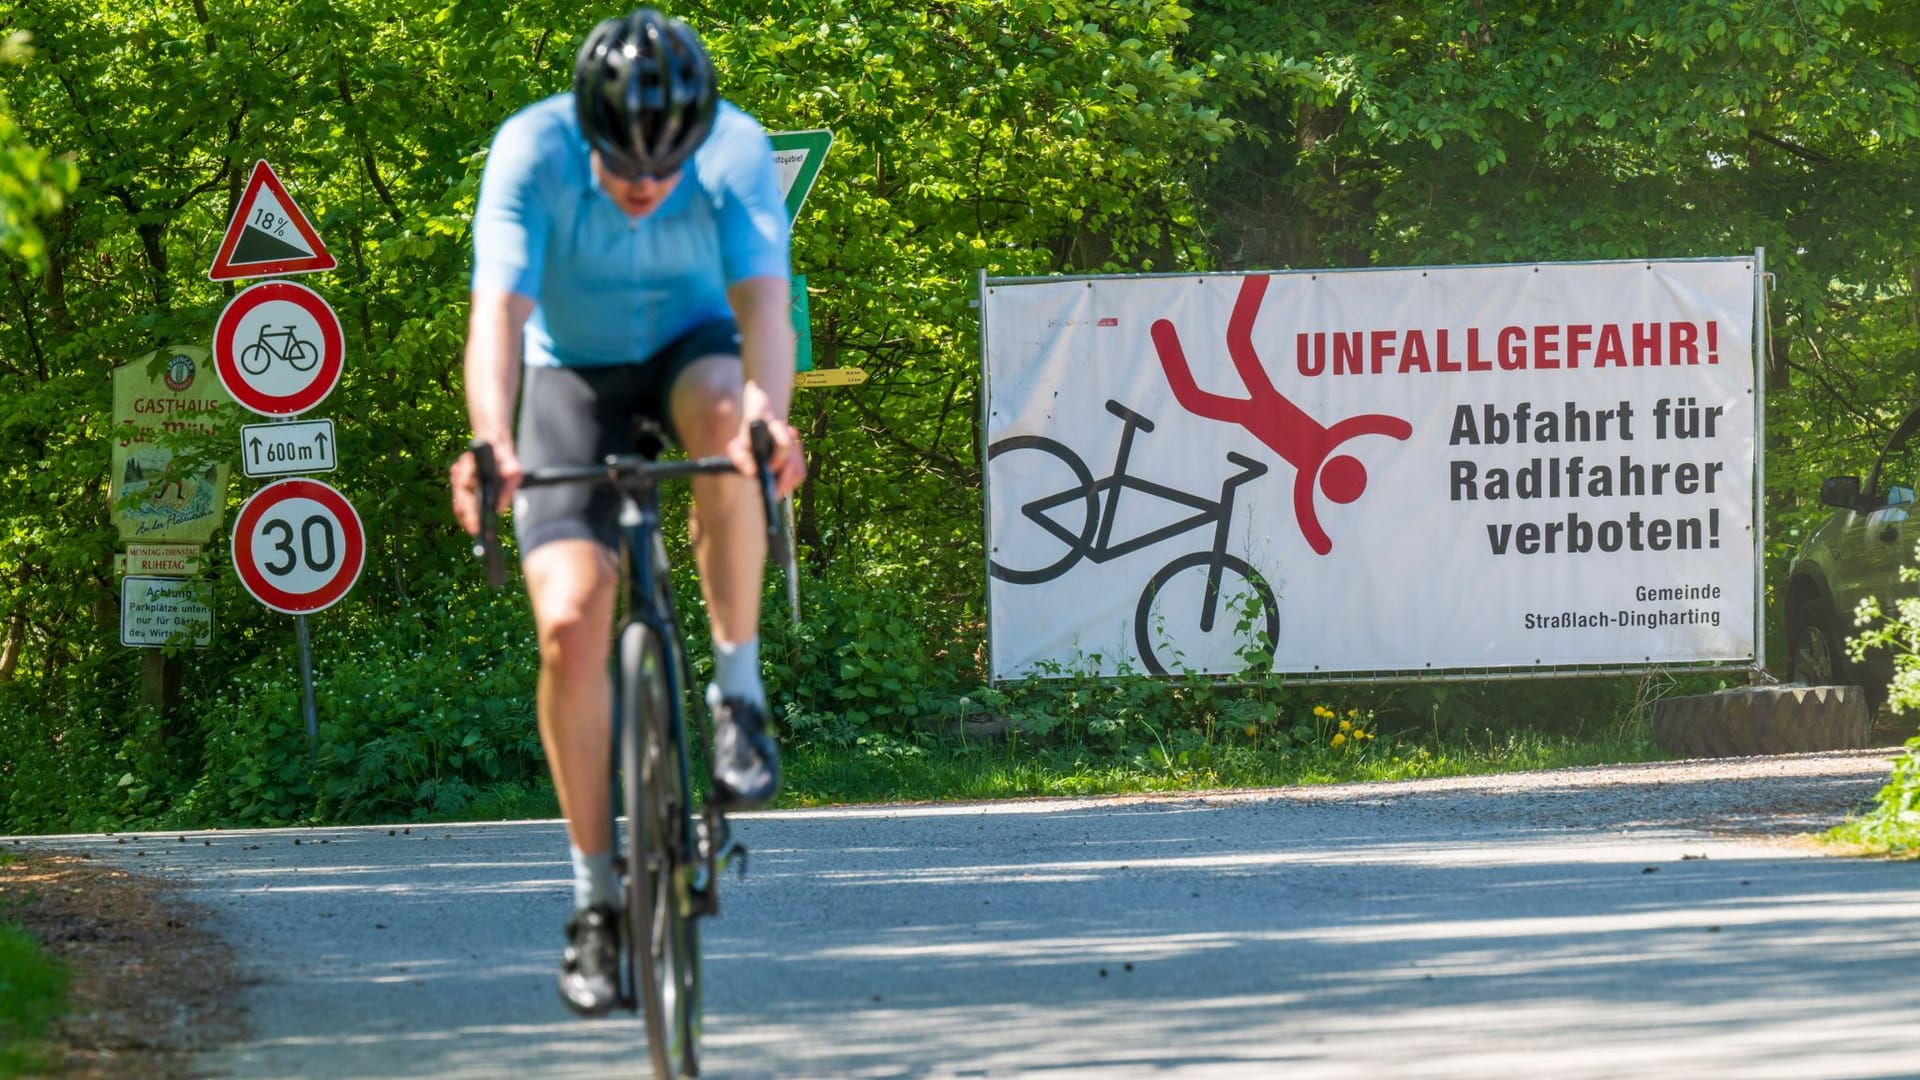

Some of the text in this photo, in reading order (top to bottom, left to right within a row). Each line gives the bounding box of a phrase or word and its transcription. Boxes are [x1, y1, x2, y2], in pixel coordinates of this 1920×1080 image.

[255, 208, 288, 237] 18%
[1297, 321, 1719, 377] UNFALLGEFAHR!
[134, 398, 217, 414] GASTHAUS
[1449, 397, 1723, 446] Abfahrt für
[1450, 457, 1723, 502] Radlfahrer
[1487, 508, 1720, 555] verboten!
[129, 548, 160, 556] MONTAG
[262, 515, 336, 576] 30
[142, 560, 185, 570] RUHETAG
[1636, 584, 1721, 602] Gemeinde
[129, 602, 207, 614] Parkplätze unten
[136, 617, 152, 625] nur
[156, 616, 169, 625] für
[1525, 609, 1720, 630] Straßlach-Dingharting
[129, 629, 145, 638] des
